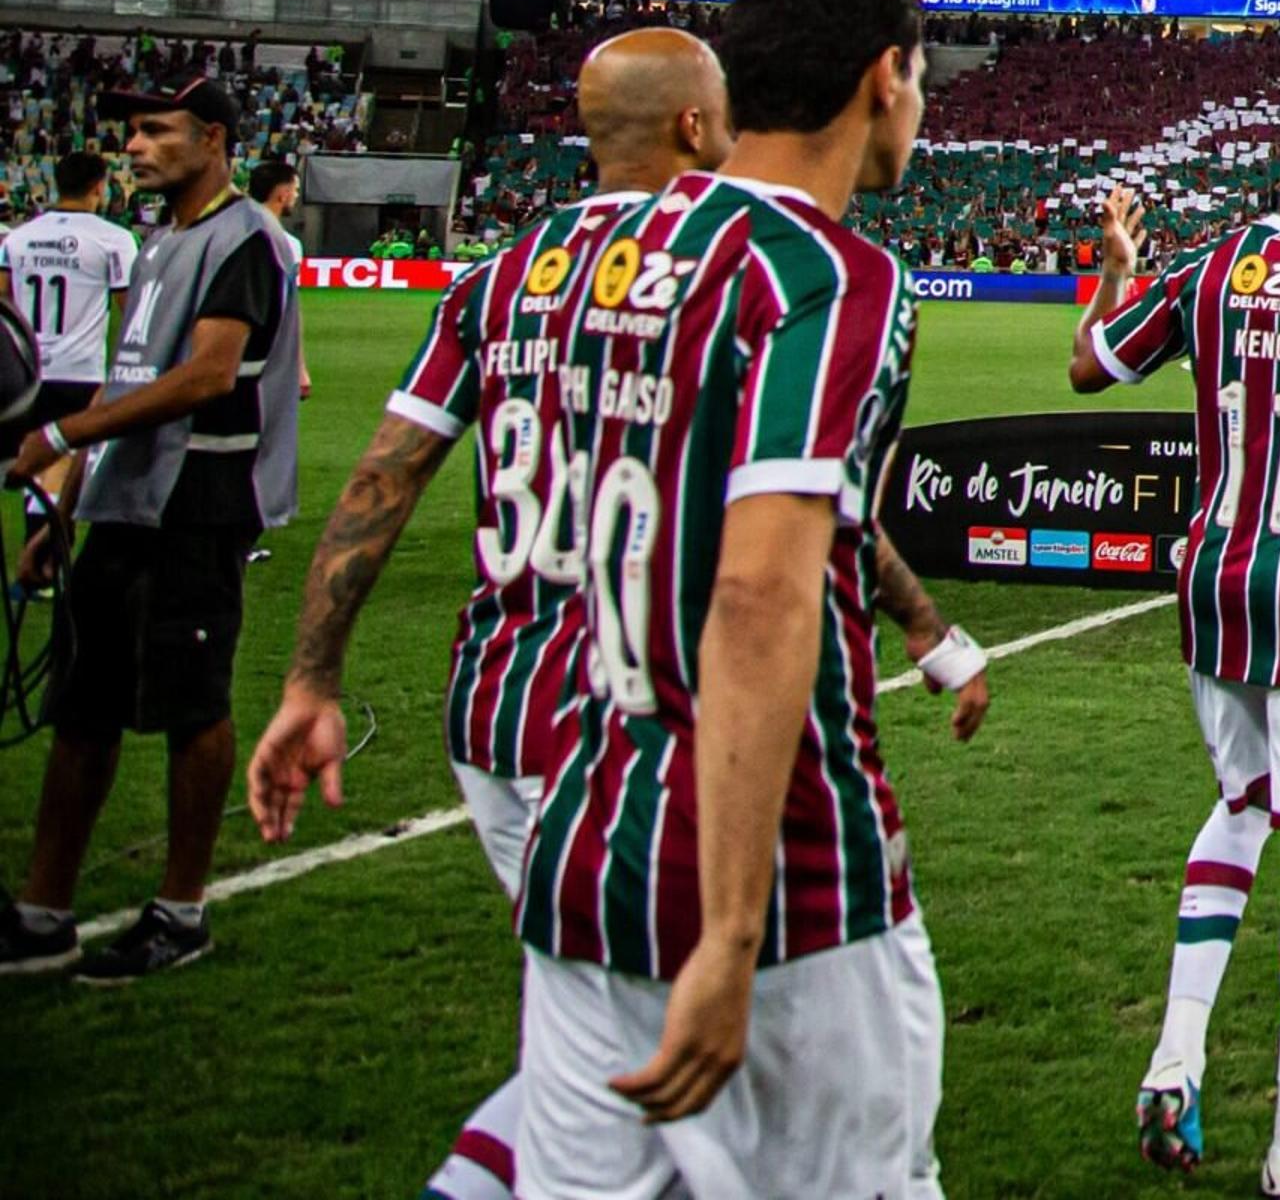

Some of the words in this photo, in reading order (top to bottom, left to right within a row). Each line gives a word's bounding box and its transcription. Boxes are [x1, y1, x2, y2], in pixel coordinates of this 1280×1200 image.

[33, 255, 79, 269] TORRES
[307, 259, 408, 288] TCL
[26, 275, 66, 335] 11
[585, 309, 668, 339] DELIVERY
[906, 454, 952, 512] Rio
[967, 461, 998, 500] de
[1007, 461, 1123, 518] Janeiro
[975, 547, 1021, 561] AMSTEL
[1095, 541, 1149, 561] Coca-Cola
